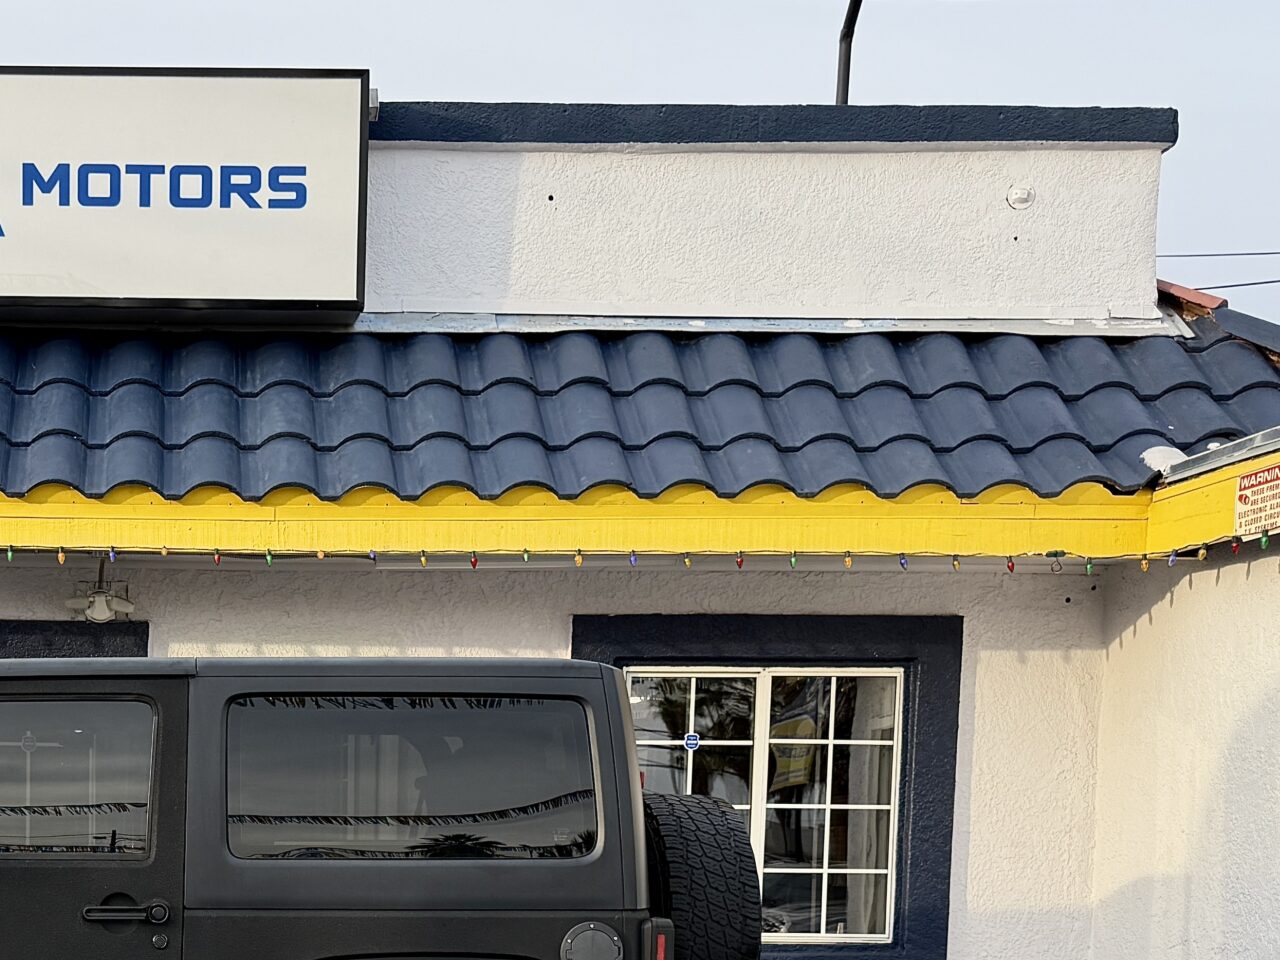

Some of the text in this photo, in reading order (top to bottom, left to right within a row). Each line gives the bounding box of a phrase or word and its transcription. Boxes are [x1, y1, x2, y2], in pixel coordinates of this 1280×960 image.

[22, 162, 308, 209] MOTORS
[1238, 504, 1267, 519] ELECTRONIC
[1245, 516, 1262, 527] CLOSED
